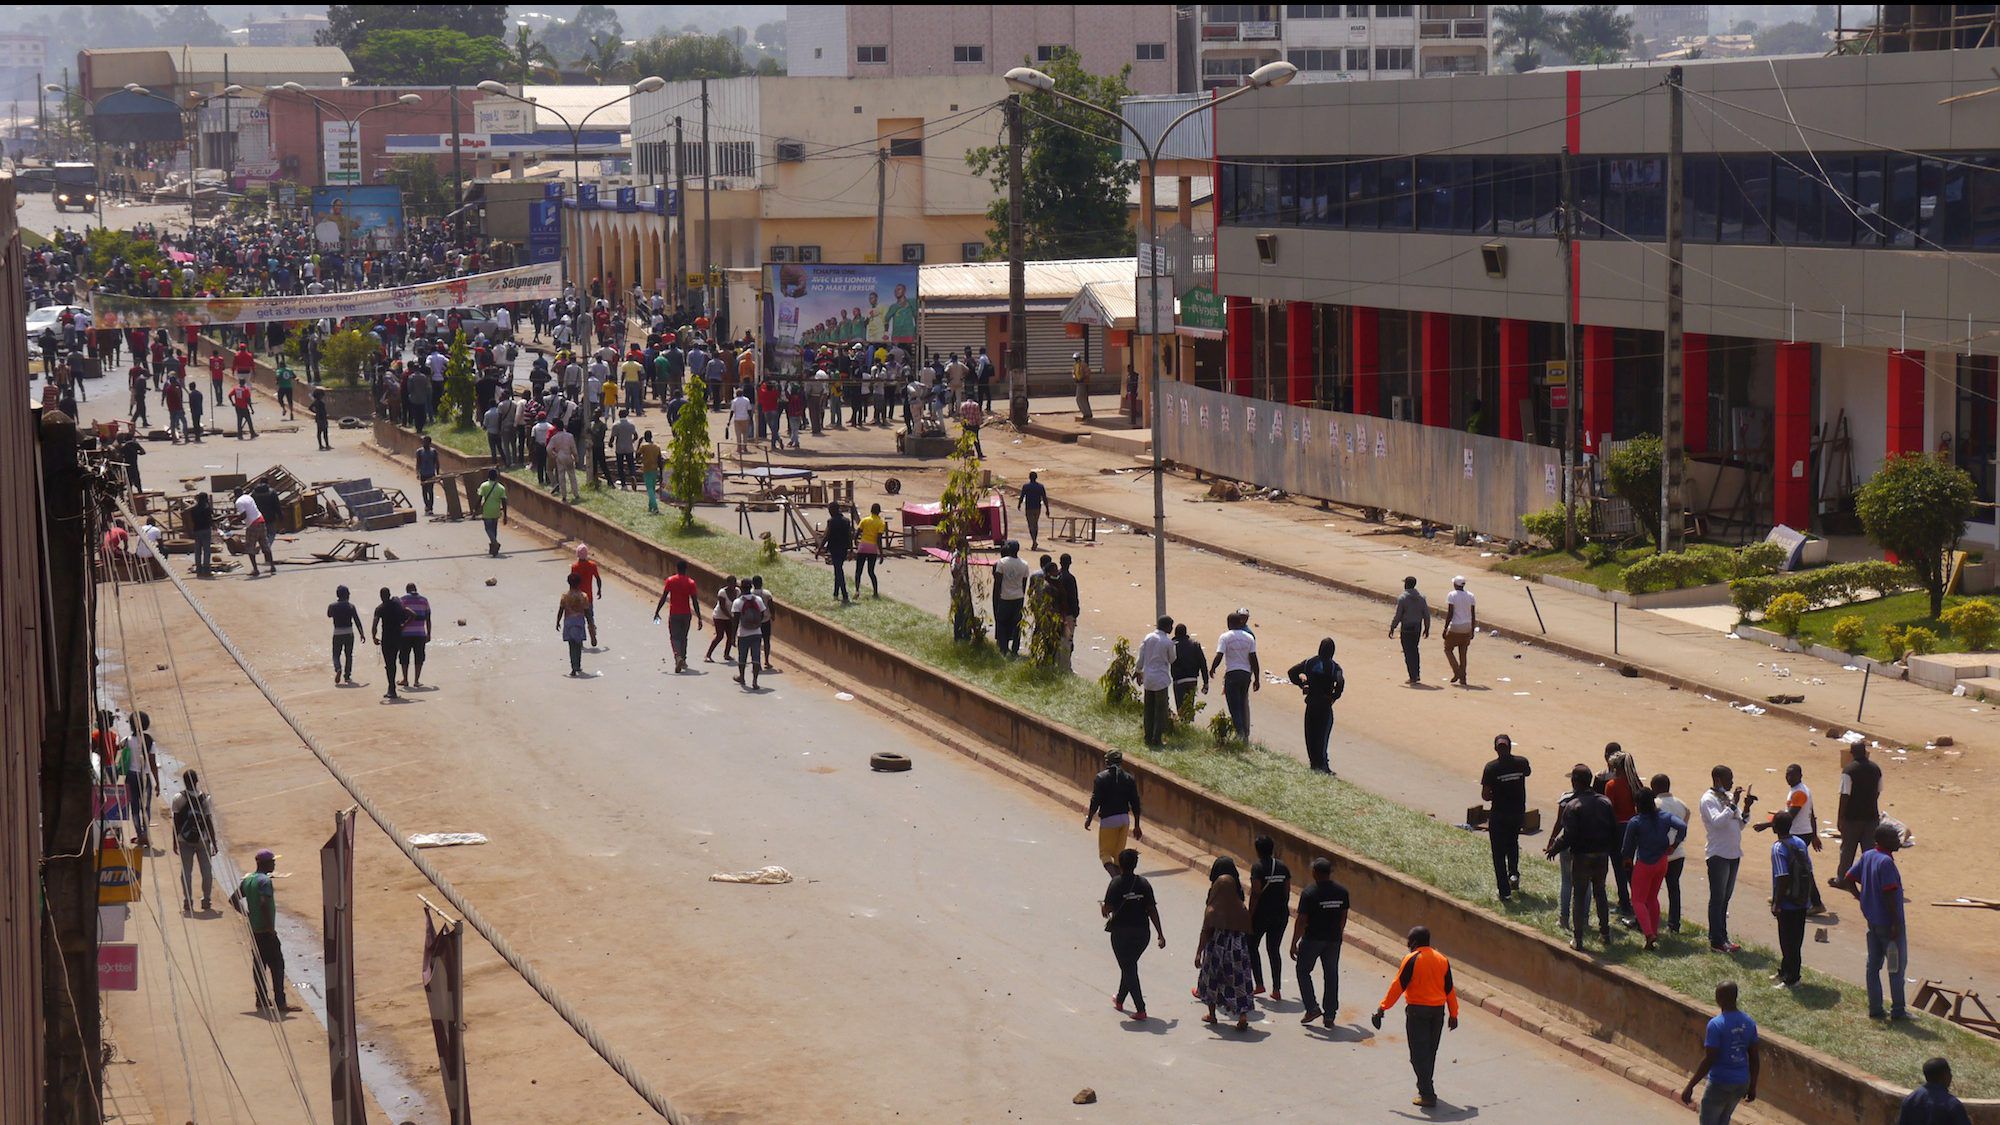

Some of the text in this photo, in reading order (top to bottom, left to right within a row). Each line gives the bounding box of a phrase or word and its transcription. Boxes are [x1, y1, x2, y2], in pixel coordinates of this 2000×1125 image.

[445, 138, 486, 148] Oibya
[502, 273, 552, 289] Seigneurie
[257, 308, 274, 318] get
[298, 306, 318, 315] one
[320, 304, 334, 313] for
[336, 302, 356, 312] free
[99, 870, 132, 882] MTN
